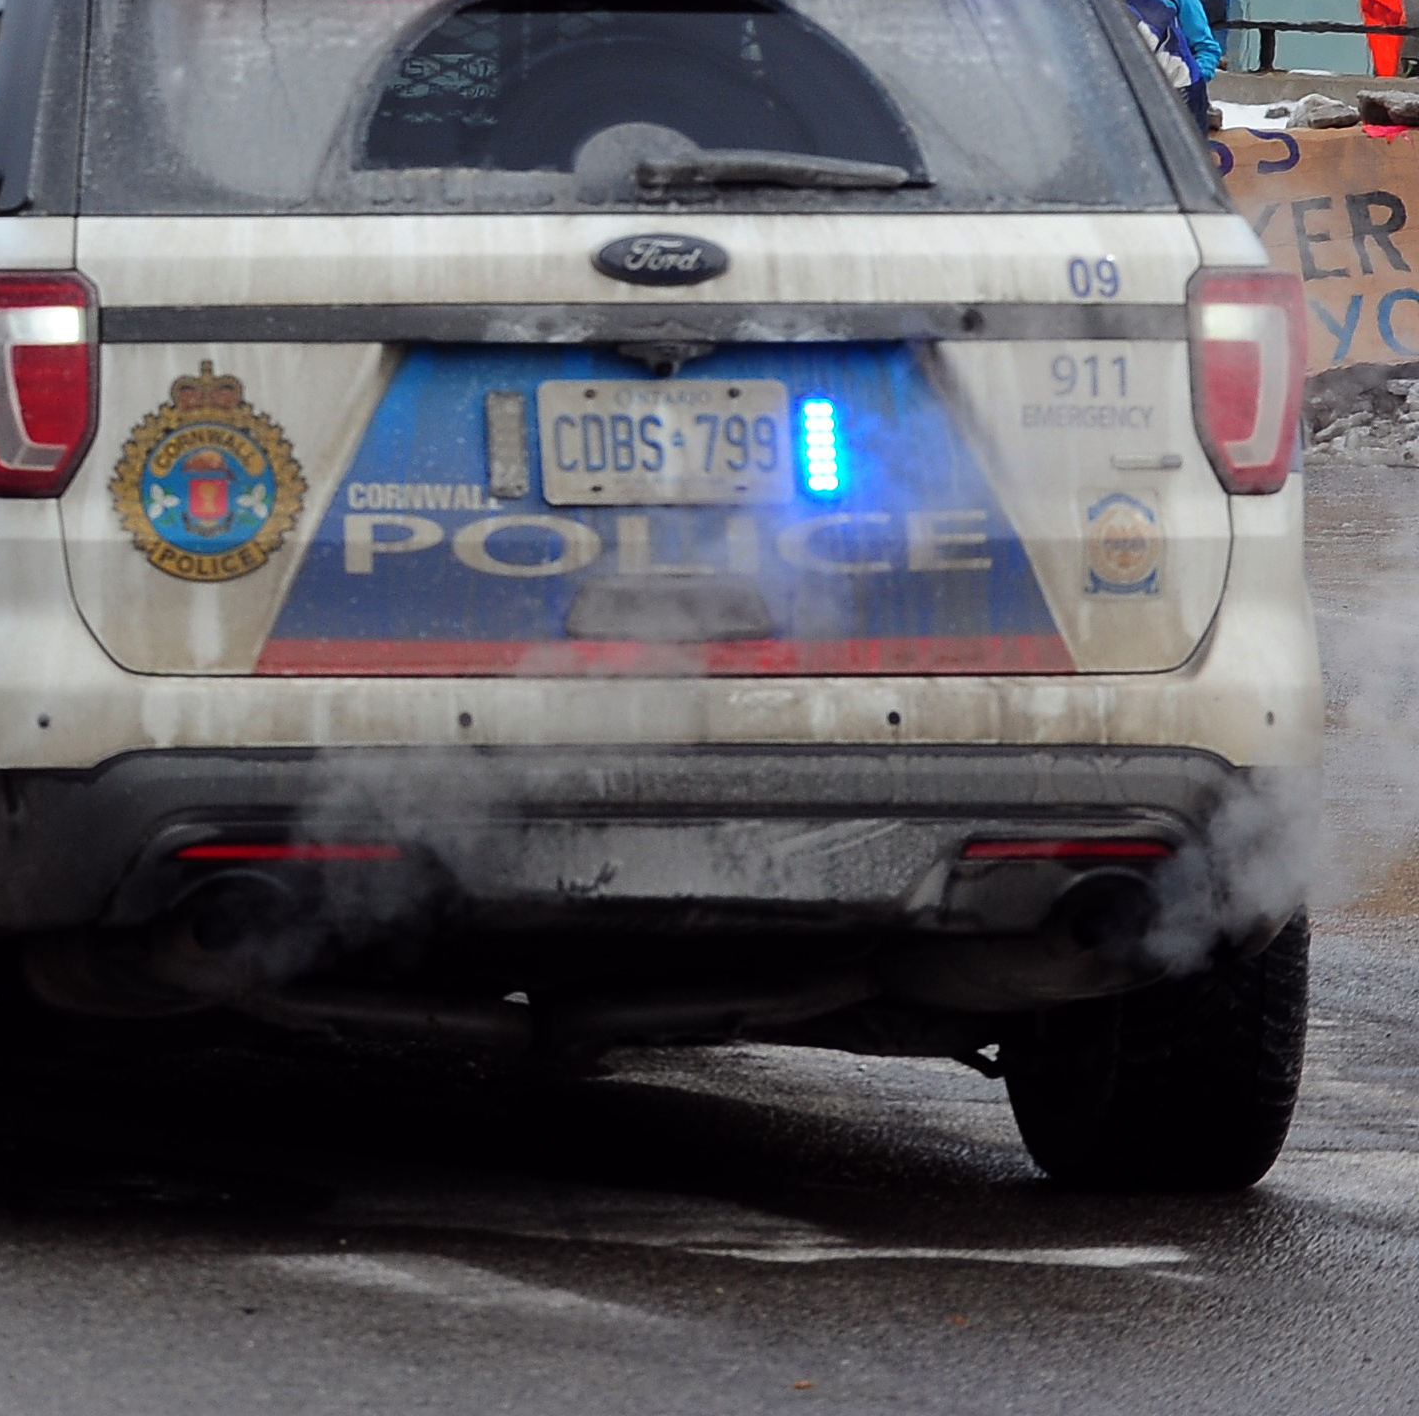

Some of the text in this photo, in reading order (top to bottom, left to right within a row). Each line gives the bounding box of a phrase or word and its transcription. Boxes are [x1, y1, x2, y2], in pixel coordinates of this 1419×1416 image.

[623, 237, 703, 272] Ford
[1067, 257, 1121, 299] 09
[1051, 354, 1128, 398] 911
[1020, 404, 1154, 429] EMERGENCY
[158, 546, 260, 577] POLICE
[343, 510, 994, 578] POLICE
